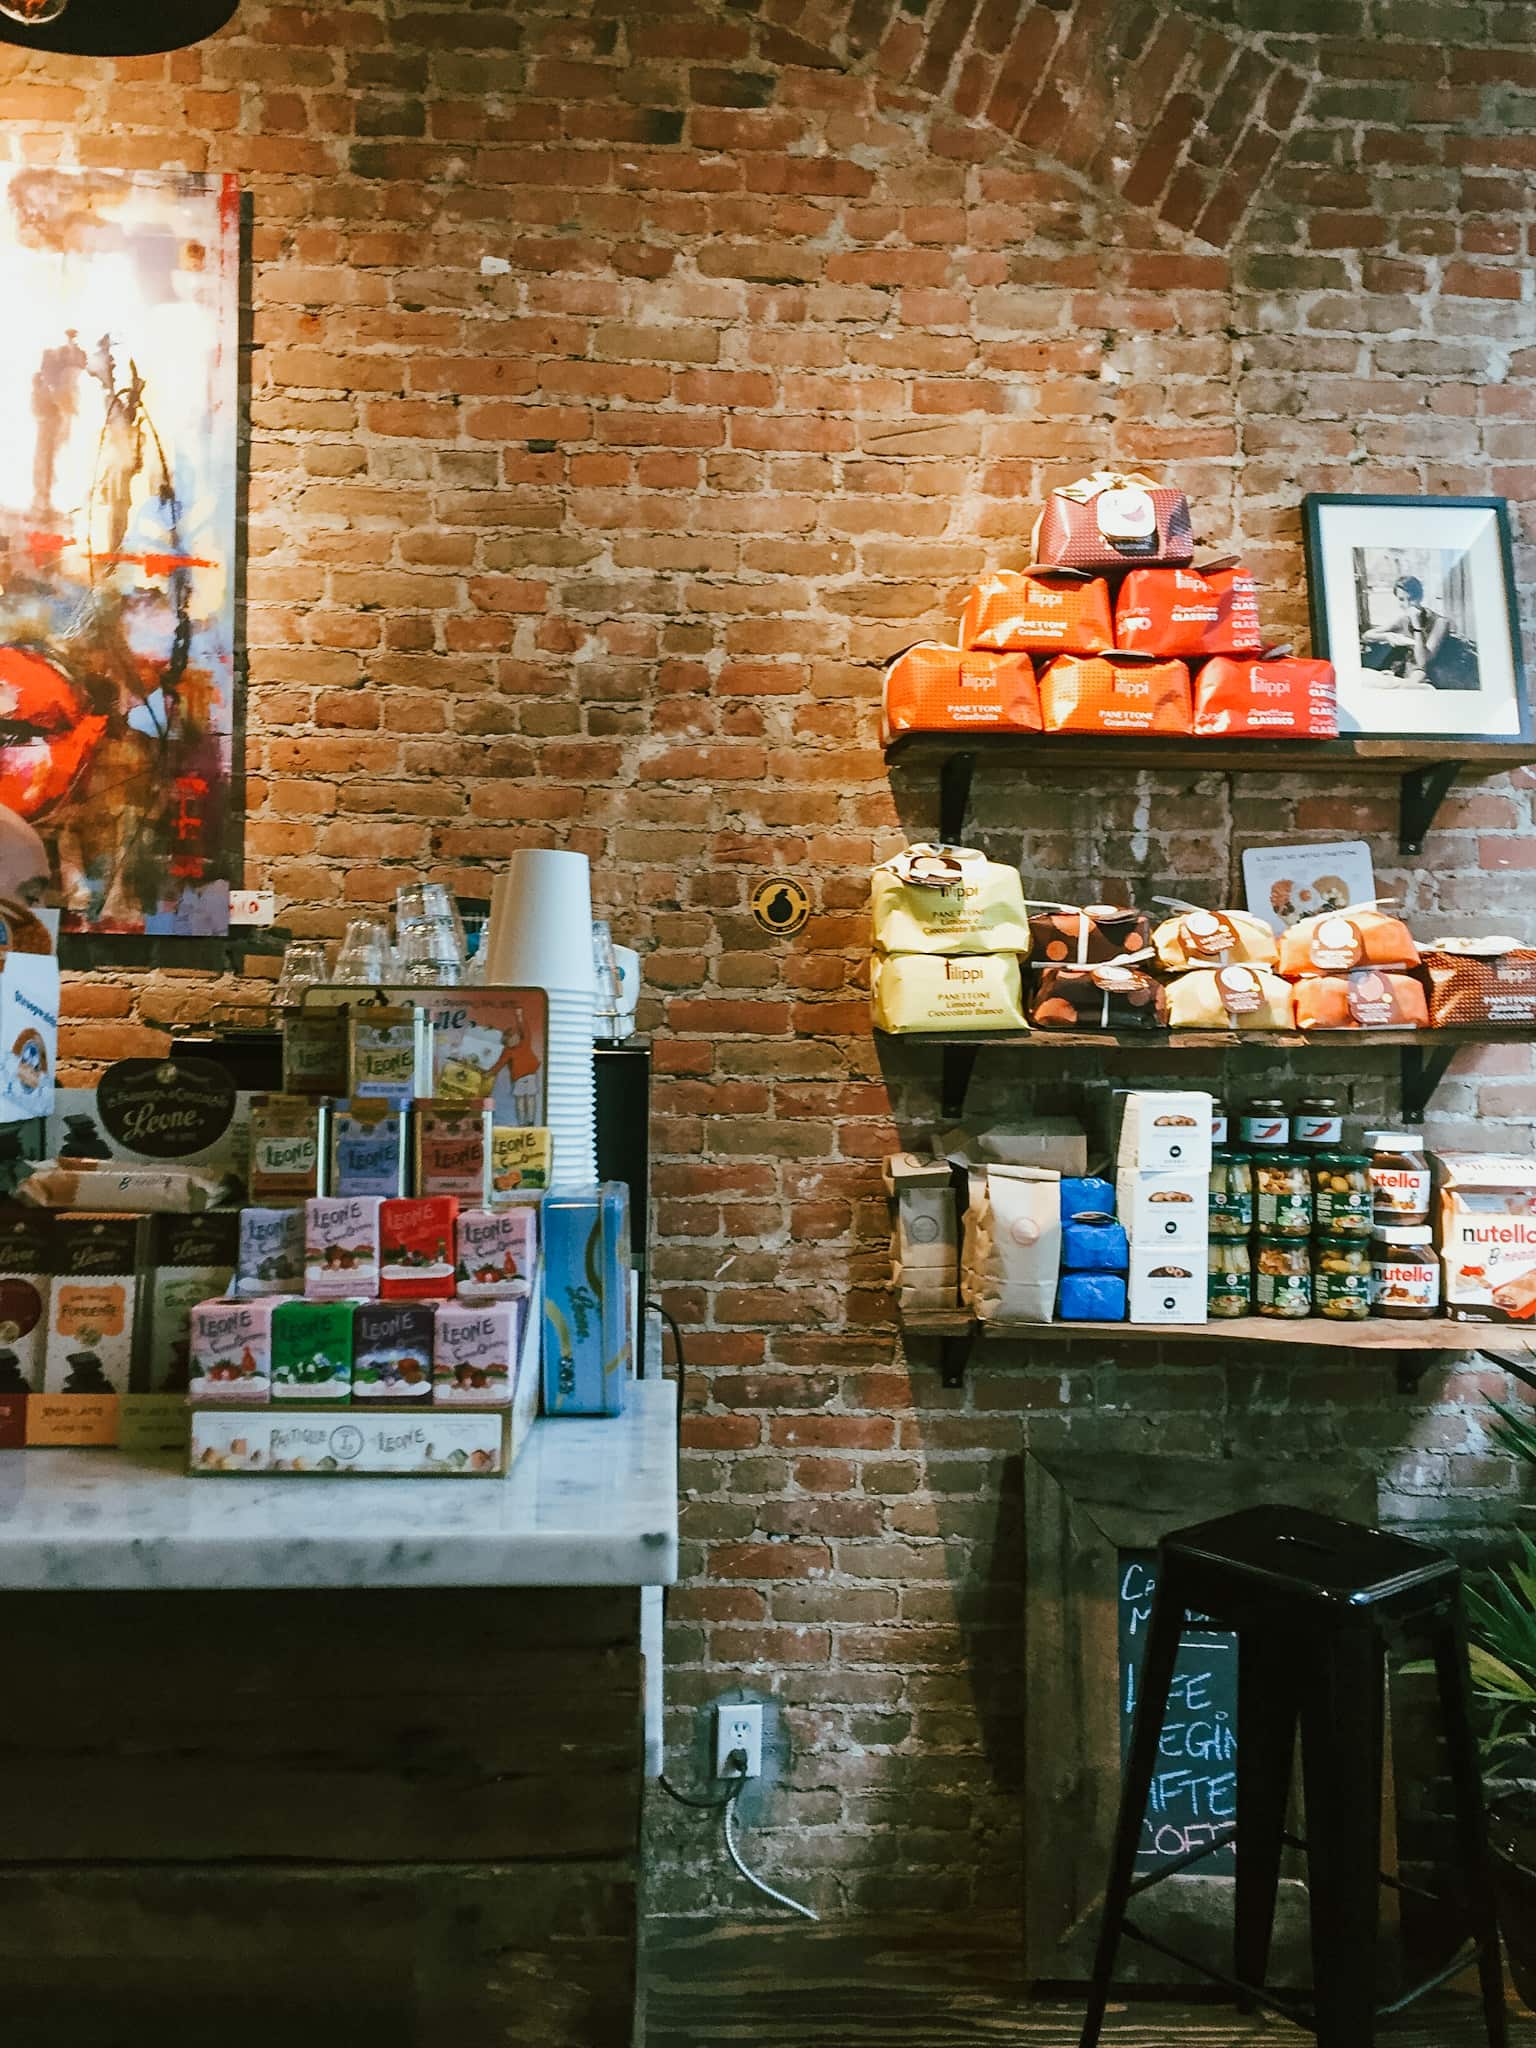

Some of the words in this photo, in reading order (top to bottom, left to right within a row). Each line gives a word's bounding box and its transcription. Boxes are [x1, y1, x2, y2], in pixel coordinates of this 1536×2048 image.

[946, 704, 1003, 714] PANETTONE
[1098, 709, 1154, 721] PANETTONE
[937, 991, 991, 1000] PANETTONE
[366, 1051, 414, 1075] LEONE
[265, 1141, 313, 1167] LEONE
[347, 1144, 394, 1170] LEONE
[433, 1144, 482, 1169] LEONE
[1372, 1172, 1420, 1188] utella
[312, 1202, 362, 1229] LEONE
[385, 1203, 434, 1231] LEONE
[464, 1217, 514, 1244] LEONE
[1372, 1266, 1433, 1282] nutella
[197, 1310, 253, 1338] LEONE
[361, 1311, 416, 1340] LEONE
[441, 1318, 496, 1345] LEONE
